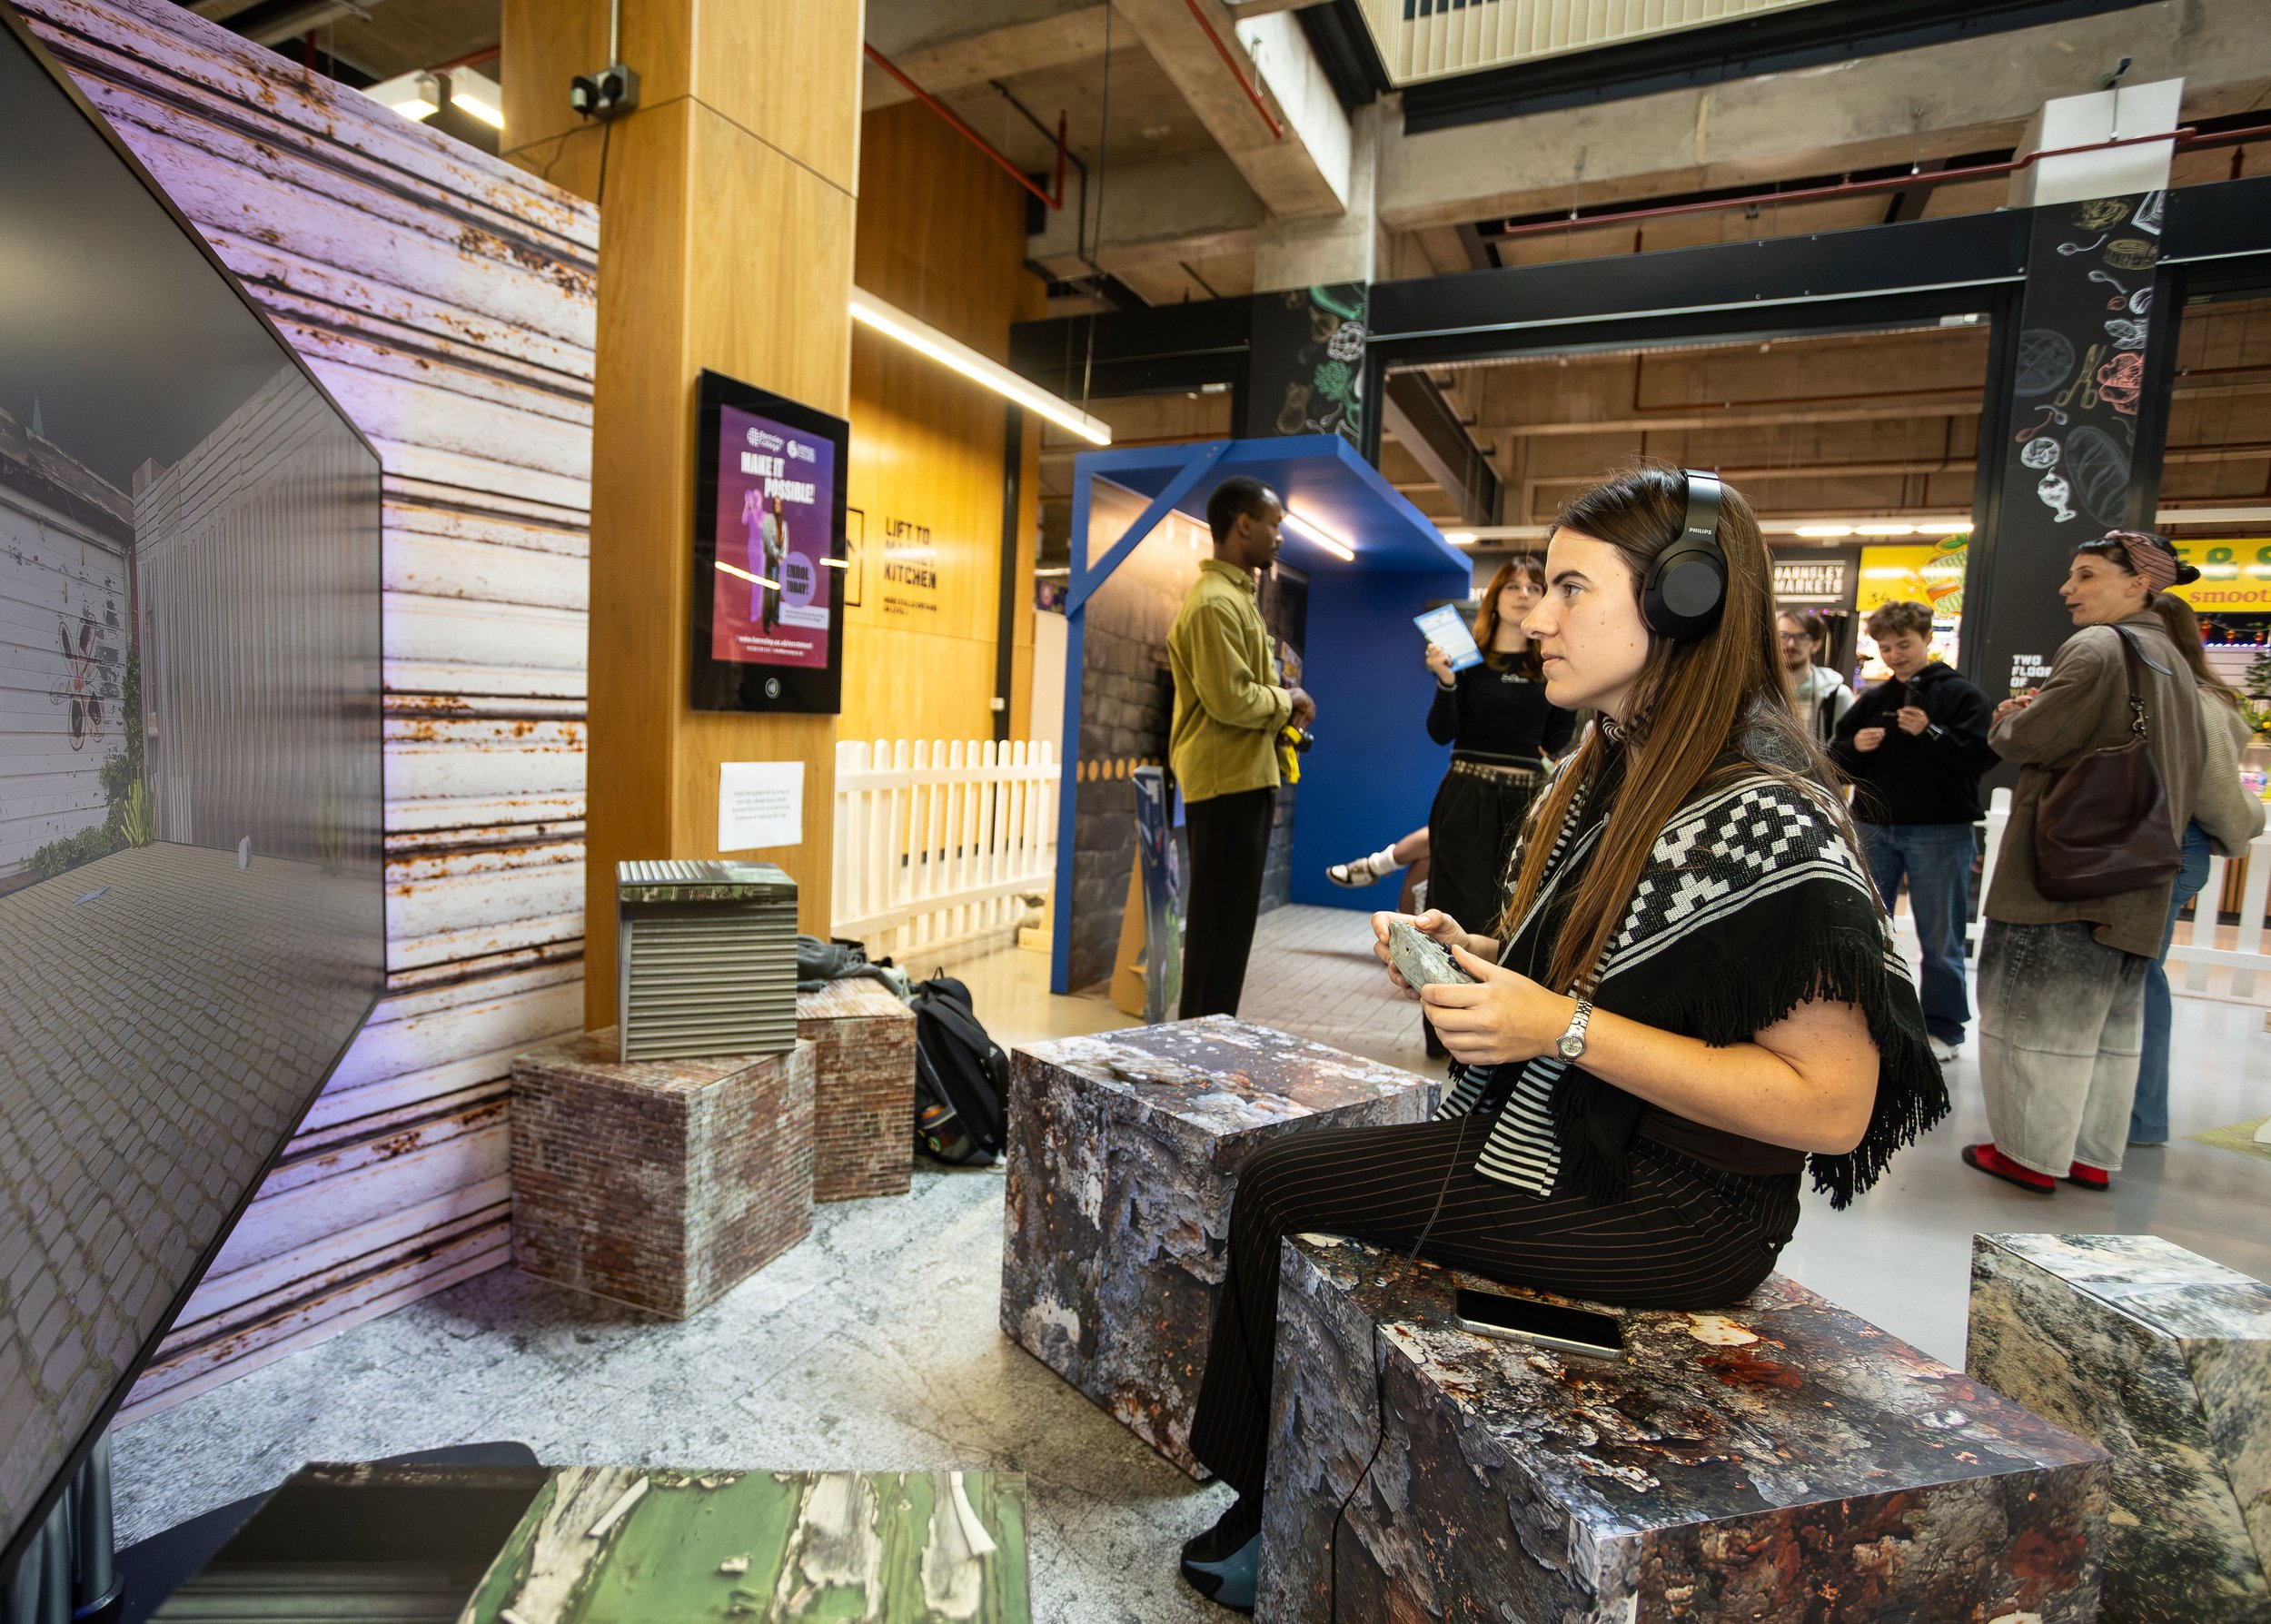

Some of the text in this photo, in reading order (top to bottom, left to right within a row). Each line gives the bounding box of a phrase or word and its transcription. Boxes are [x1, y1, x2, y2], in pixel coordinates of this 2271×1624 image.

[740, 451, 772, 479] MAKE
[773, 457, 785, 480] IT
[764, 477, 816, 505] POSSIBLE!
[886, 516, 930, 546] LIFT TO
[1689, 527, 1712, 535] PHILIPS
[786, 563, 809, 581] ENROL
[884, 561, 937, 589] KITCHEN
[786, 579, 808, 596] TODAY!
[1773, 578, 1843, 594] MARKETS
[2189, 589, 2271, 603] smoot
[2012, 654, 2042, 666] TWO
[2009, 676, 2028, 688] OF
